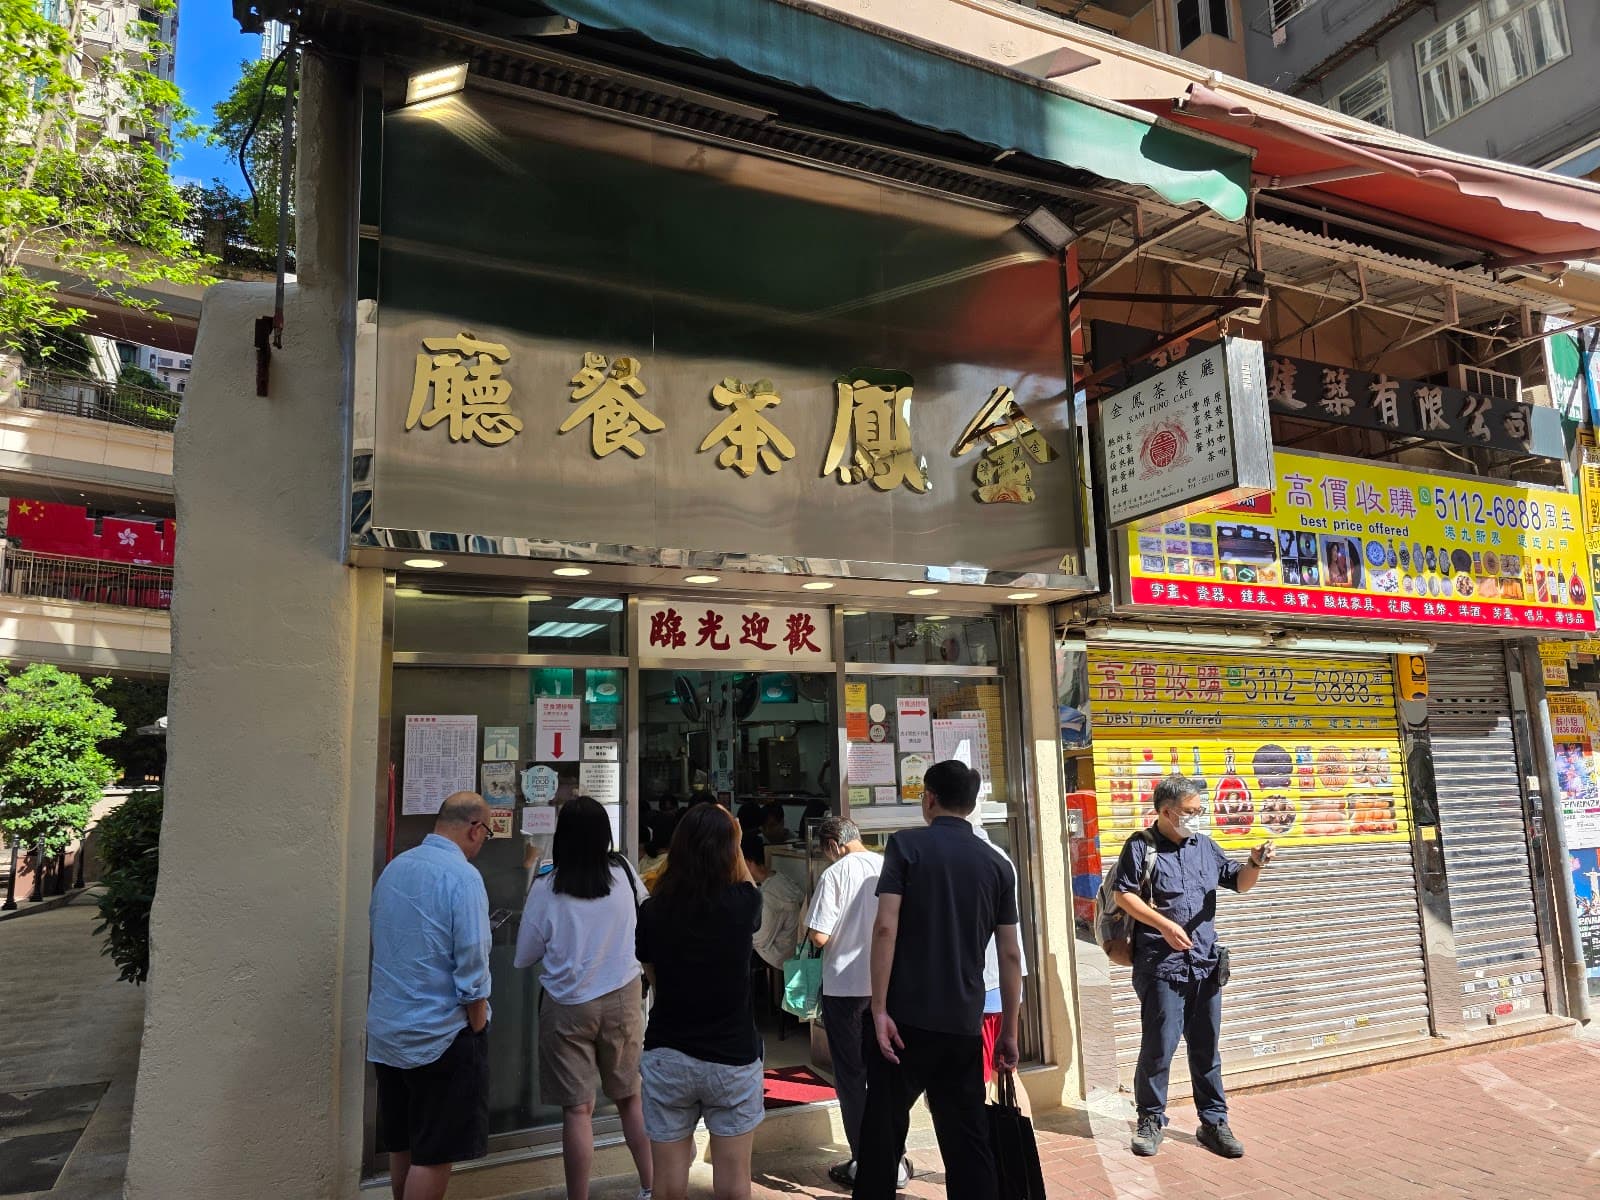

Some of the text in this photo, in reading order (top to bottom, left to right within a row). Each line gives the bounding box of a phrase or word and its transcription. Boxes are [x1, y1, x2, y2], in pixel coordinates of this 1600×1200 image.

[1111, 358, 1215, 420] 金鳳茶餐廳
[1128, 388, 1194, 424] KAM FUNG CAFE
[1284, 474, 1417, 519] 高價收購
[1435, 488, 1542, 530] 5112-6888
[1300, 514, 1409, 537] best price offered
[1544, 503, 1575, 531] 周生
[1444, 525, 1501, 546] 港九新界
[1058, 554, 1078, 577] 41
[1096, 661, 1223, 702] 高價收購
[1243, 668, 1370, 704] 5112-6888
[1105, 710, 1223, 726] best price offered
